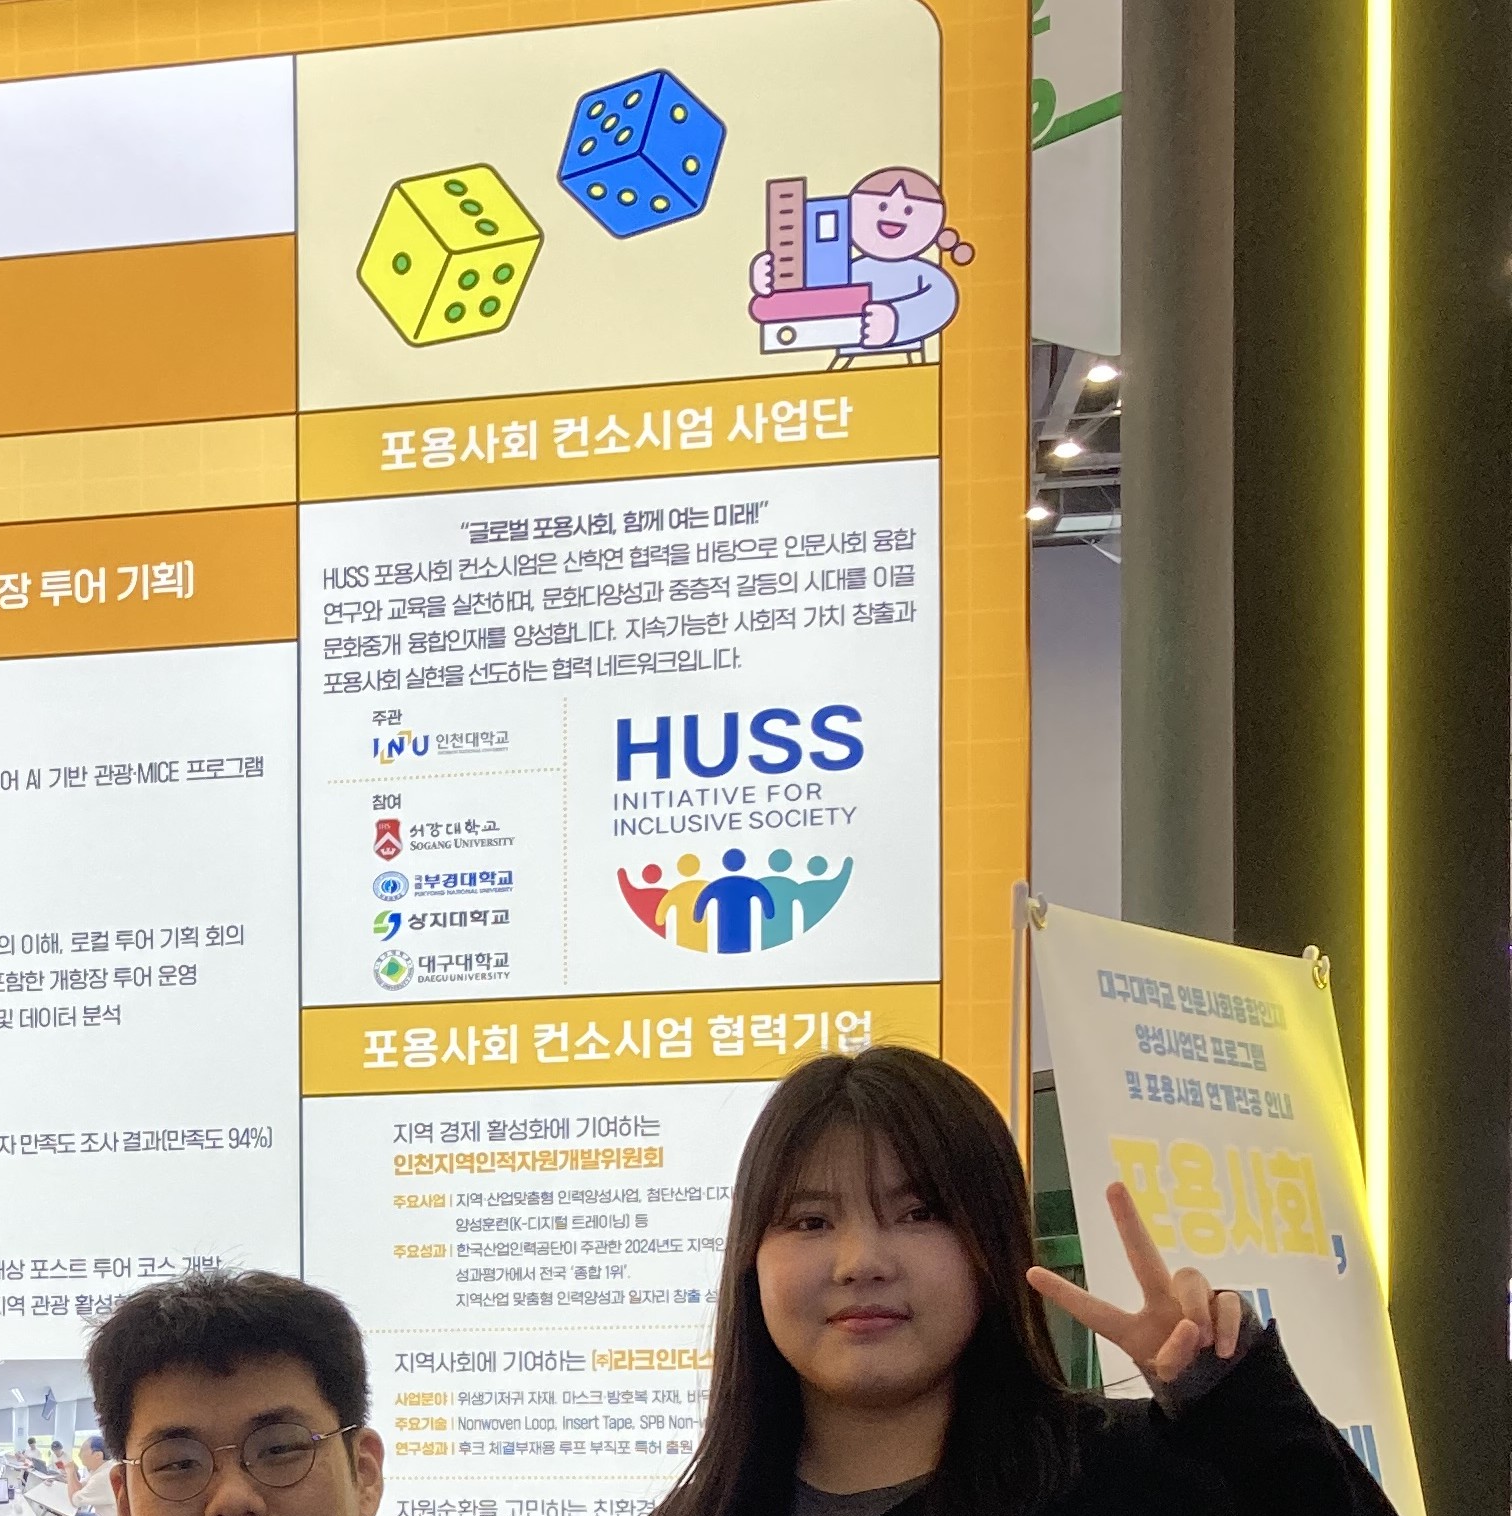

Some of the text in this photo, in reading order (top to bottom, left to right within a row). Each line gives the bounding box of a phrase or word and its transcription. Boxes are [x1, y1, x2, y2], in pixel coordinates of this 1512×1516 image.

[381, 396, 853, 470] 포용사회 컨소시엄 사업단
[624, 509, 663, 534] 함께
[669, 507, 709, 529] 여는
[324, 527, 916, 590] HUSS 포용사회 컨소시엄은 산학연 협력을 바탕으로 인문사회 융합
[40, 566, 105, 606] 투어
[324, 647, 741, 694] 포용사회 실현을 선도하는 협력 네트워크입니다.
[373, 709, 402, 726] 주관
[435, 731, 510, 750] 인천대학교
[616, 705, 865, 782] HUSS
[373, 794, 401, 810] 참여
[614, 782, 821, 811] INITIATIVE FOR
[614, 807, 856, 836] INCLUSIVE SOCIETY
[410, 834, 515, 851] SOGANG UNIVERSITY
[424, 870, 514, 889] 부경대학교
[408, 909, 510, 930] 상지대학교
[418, 952, 510, 973] 대구대학교
[364, 1010, 872, 1068] 포용사회 컨소시엄 협력기업
[1210, 1036, 1267, 1072] 프로그램
[1145, 1073, 1204, 1107] 포용사회
[21, 1133, 76, 1155] 만족도
[81, 1131, 119, 1153] 조사
[393, 1115, 660, 1144] 지역 경제 활성화에 기여하는
[394, 1146, 664, 1176] 인천지역인적자원개발위원회
[395, 1417, 447, 1432] 주요기술
[458, 1417, 521, 1430] Nonwoven
[562, 1415, 600, 1430] Insert
[640, 1414, 664, 1430] SPB
